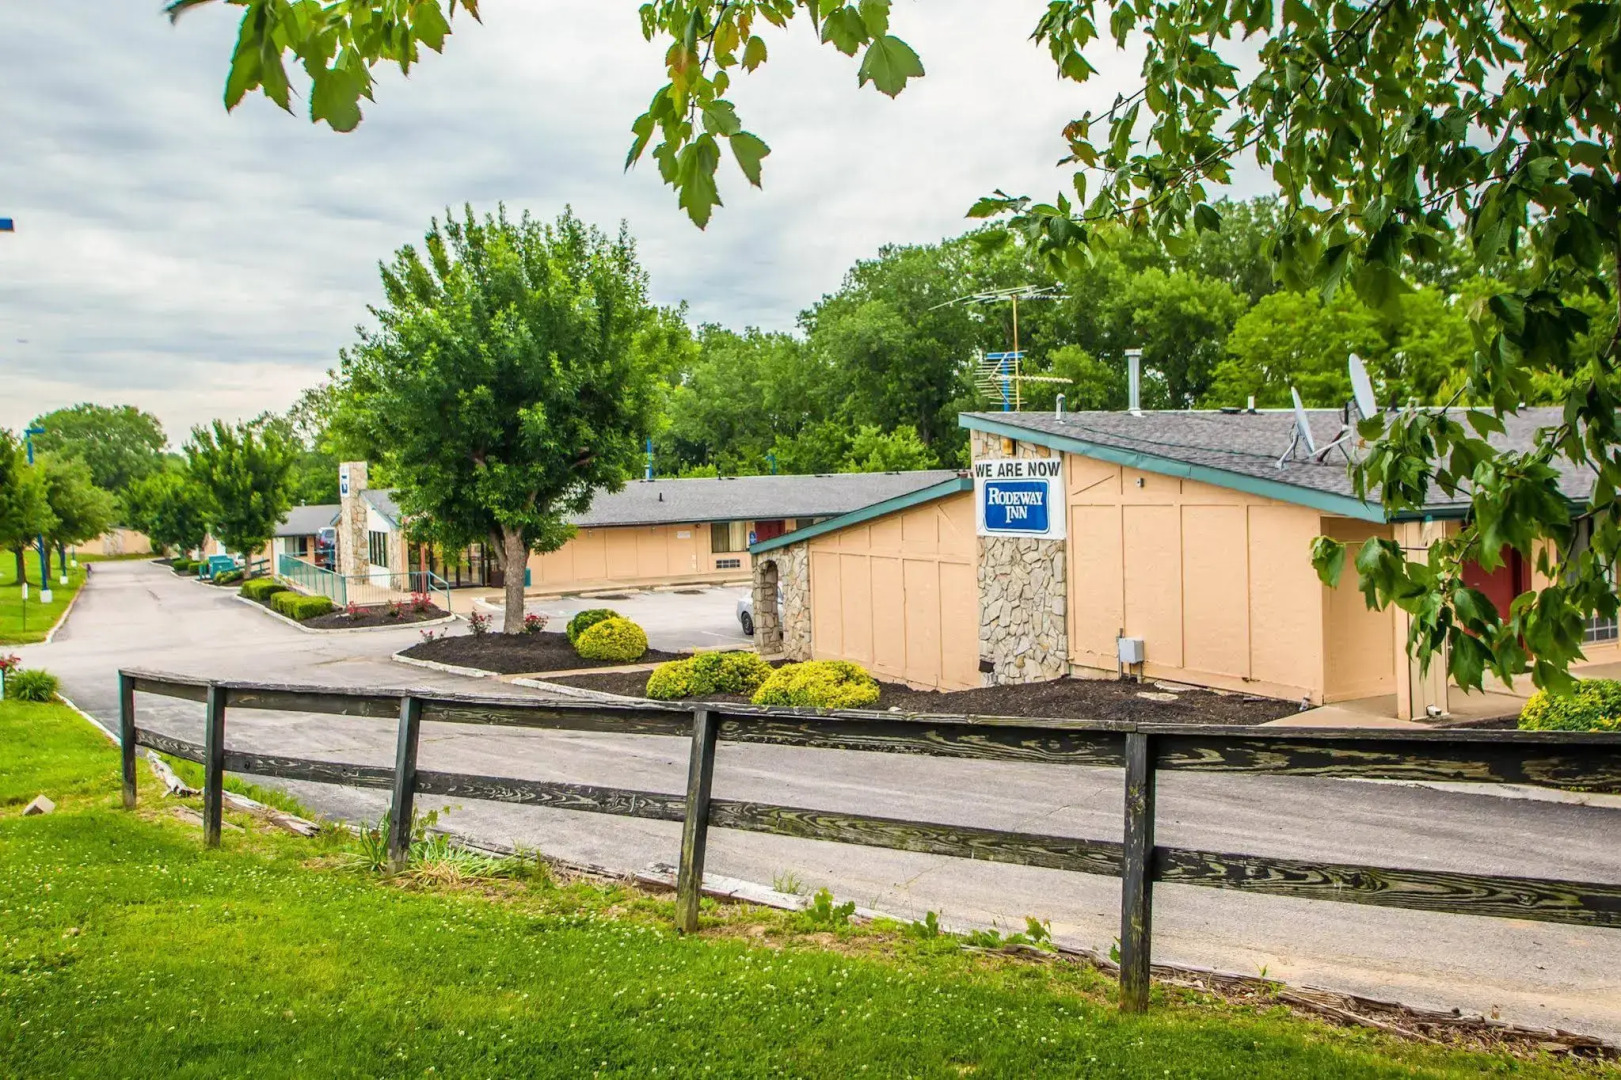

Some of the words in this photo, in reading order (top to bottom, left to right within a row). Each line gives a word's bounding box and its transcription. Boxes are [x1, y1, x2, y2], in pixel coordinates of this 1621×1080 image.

[975, 464, 993, 477] WE
[997, 463, 1023, 477] ARE
[1027, 461, 1061, 476] NOW
[987, 487, 1043, 505] RODEWAY
[1005, 505, 1028, 523] INN
